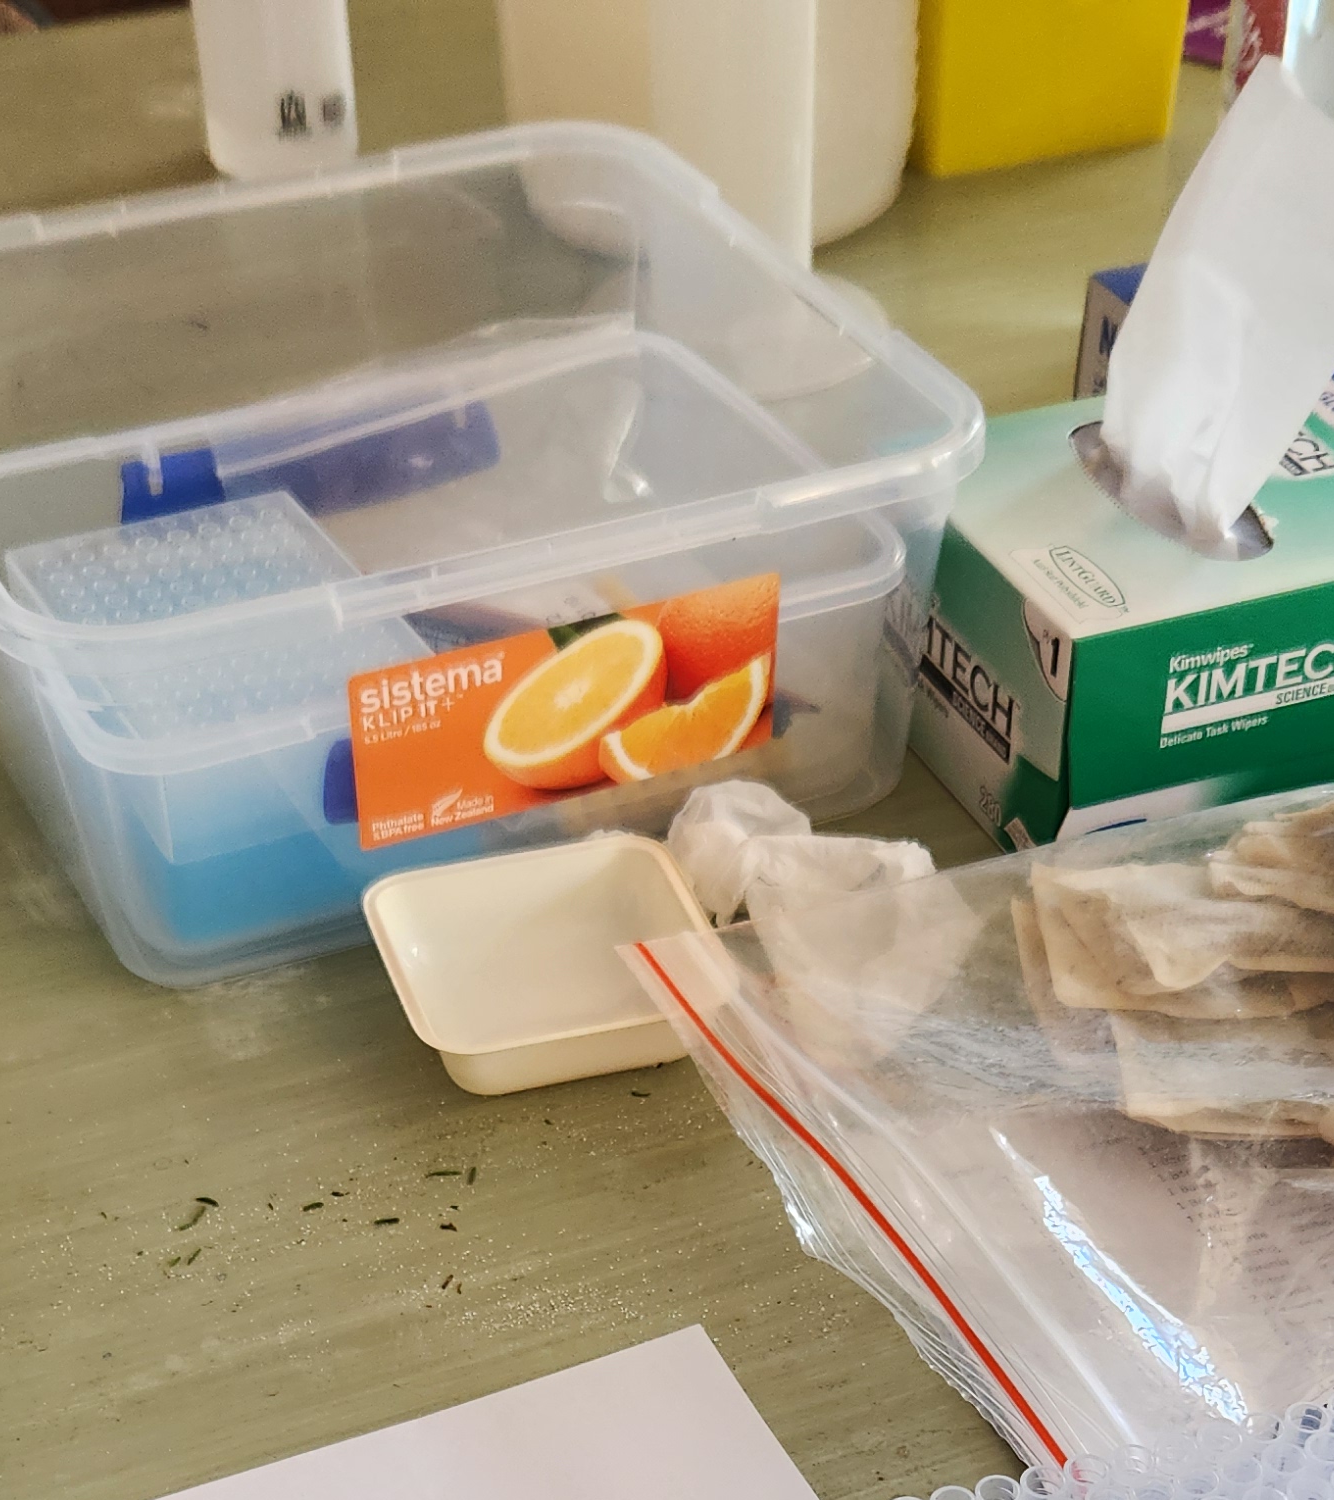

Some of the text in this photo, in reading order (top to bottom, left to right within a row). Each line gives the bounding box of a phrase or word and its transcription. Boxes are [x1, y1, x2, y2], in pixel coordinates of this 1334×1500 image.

[1169, 643, 1251, 674] Kimwipes
[360, 657, 503, 713] sistema
[1276, 682, 1327, 705] SCIENCE
[362, 699, 438, 732] KLIP IT
[1159, 715, 1269, 749] Delicate Task Wipers
[431, 804, 494, 827] New Zealand
[457, 797, 483, 810] Made
[371, 813, 425, 832] Phthalate
